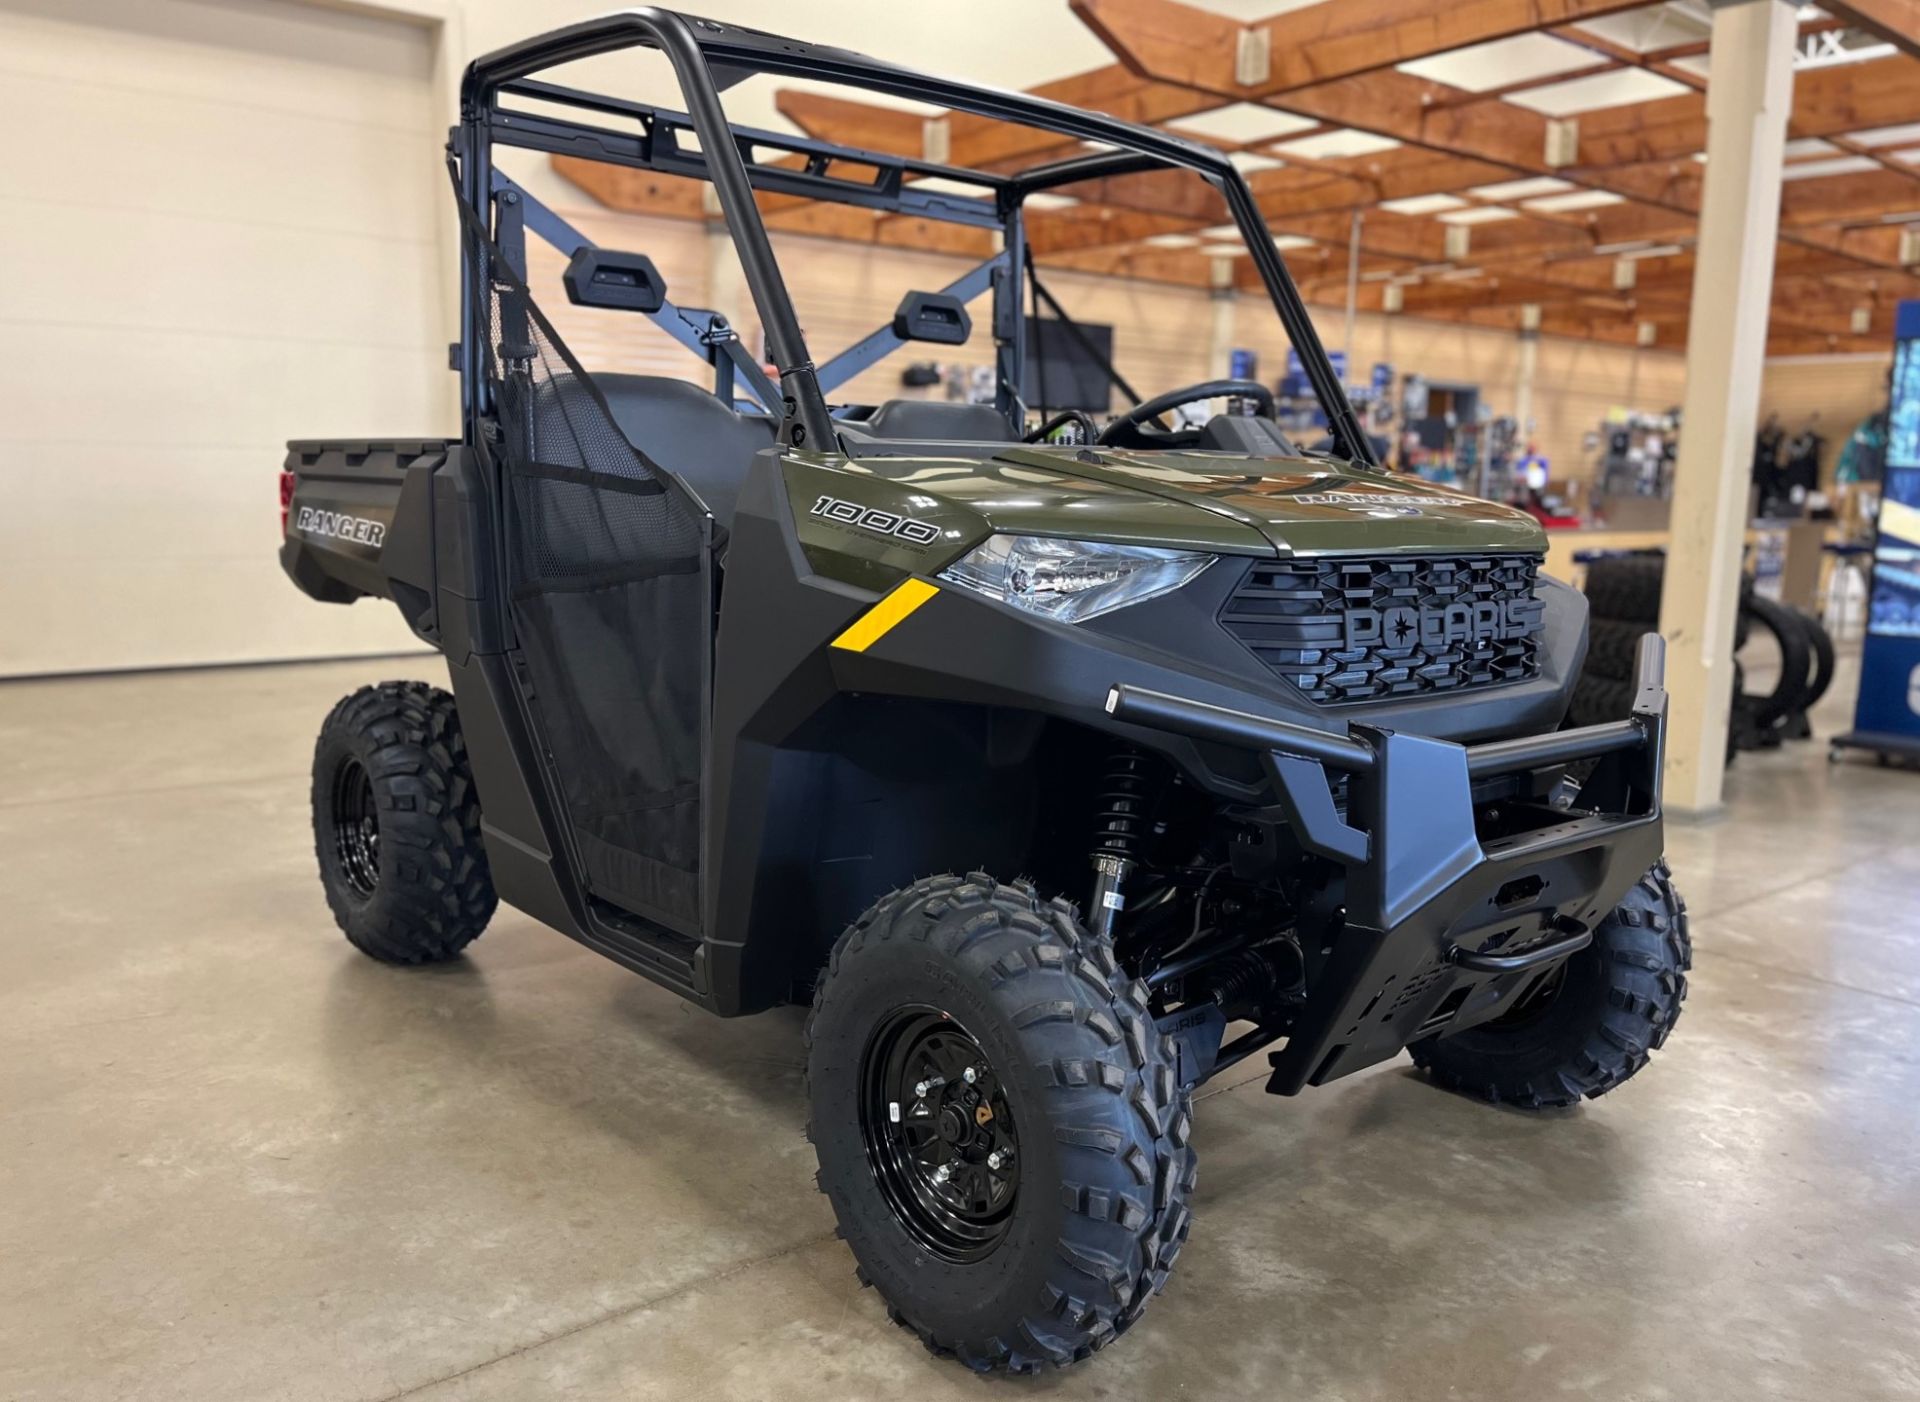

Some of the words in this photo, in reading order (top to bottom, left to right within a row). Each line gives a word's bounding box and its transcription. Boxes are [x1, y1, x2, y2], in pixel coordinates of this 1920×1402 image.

[297, 506, 386, 548] RANGER
[810, 495, 941, 545] 1000
[1344, 600, 1546, 651] POLARIS
